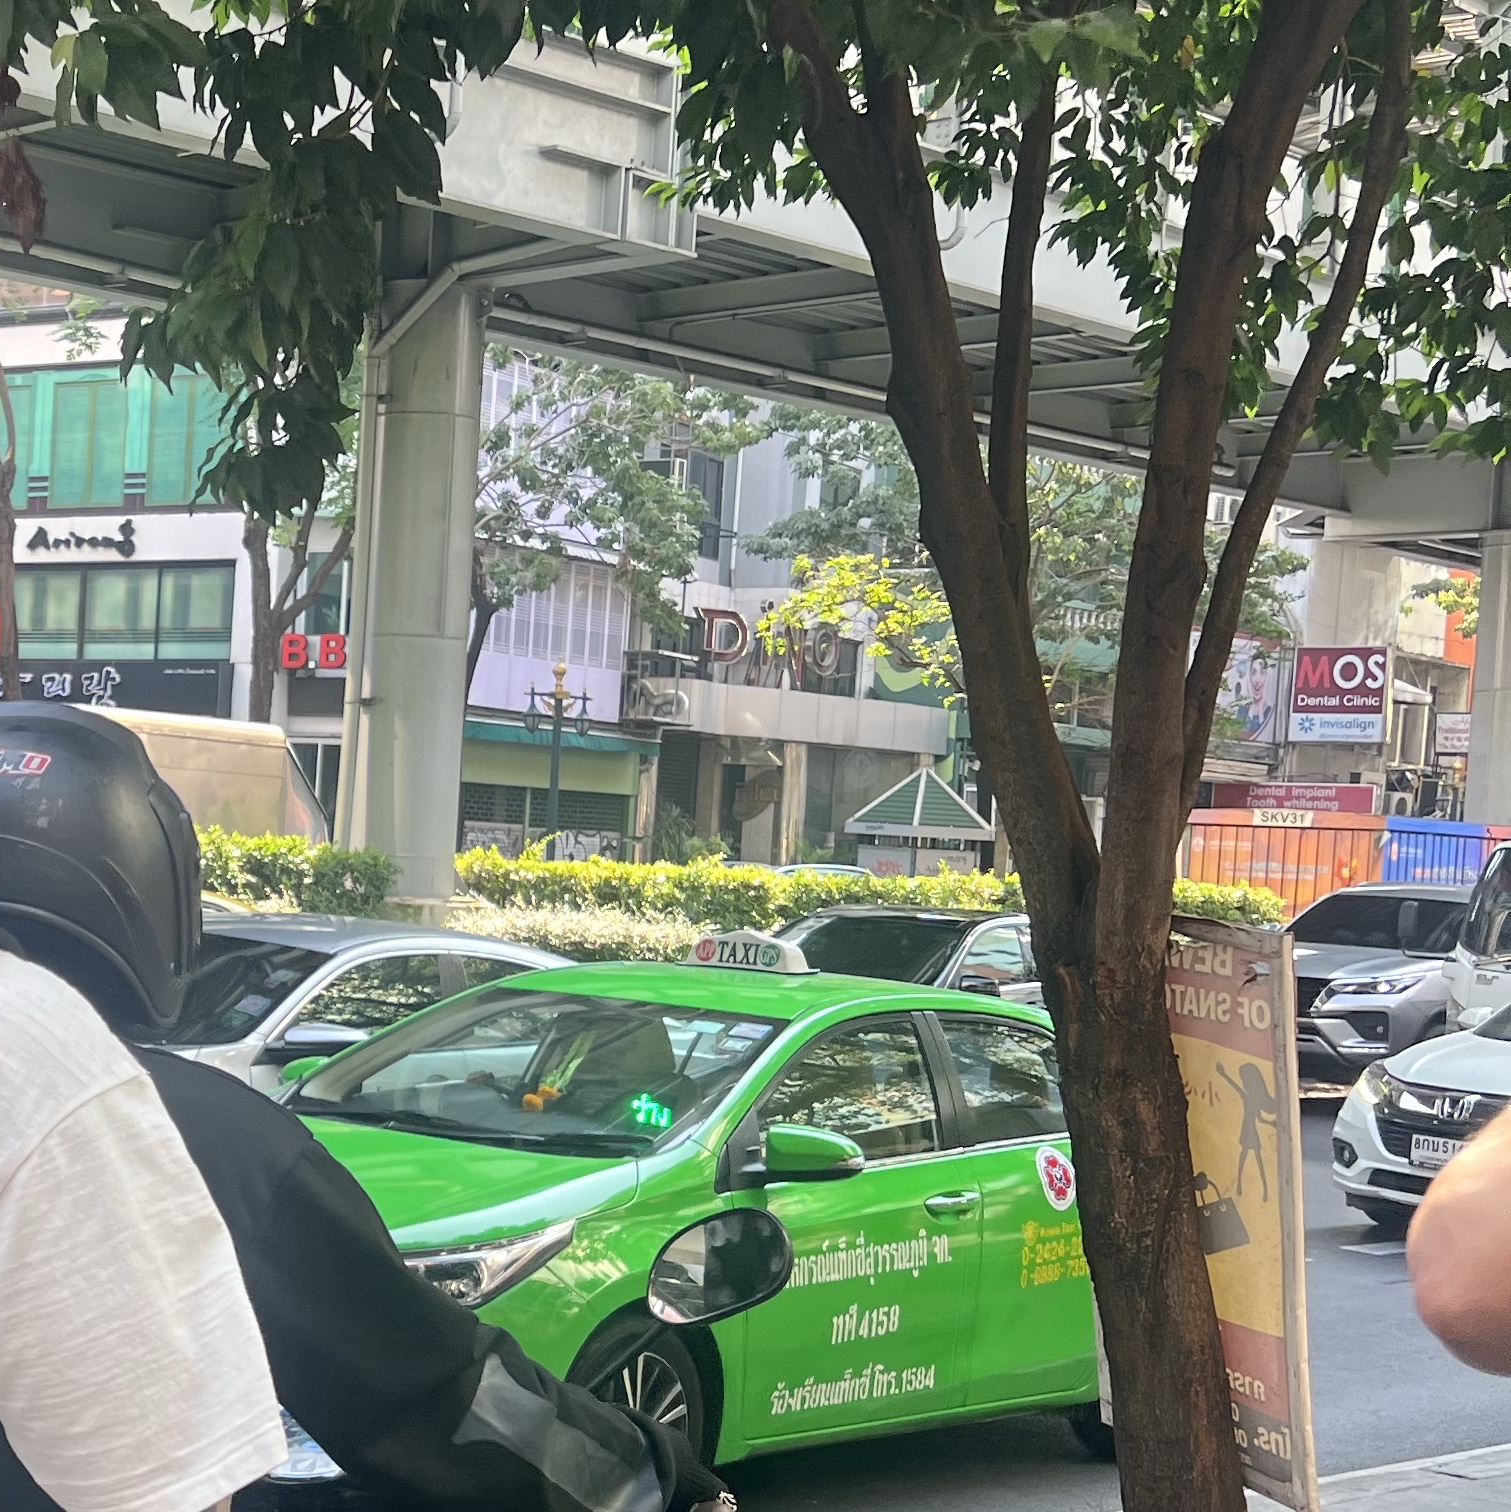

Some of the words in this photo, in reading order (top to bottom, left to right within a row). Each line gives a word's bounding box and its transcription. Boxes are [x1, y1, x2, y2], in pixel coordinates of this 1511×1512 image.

[1296, 653, 1386, 690] MOS
[1297, 694, 1340, 707] Dental
[1343, 694, 1381, 707] Clinic
[1319, 718, 1375, 733] invisalign
[1248, 786, 1286, 797] Dental
[1292, 786, 1337, 799] Implant
[1246, 797, 1277, 808] Tooth
[1283, 798, 1339, 811] whitening
[1260, 811, 1306, 825] SKV31
[717, 941, 761, 966] TAXI
[785, 1228, 928, 1289] หกรณ์แท็กซี่สุวรรณภูมิ
[859, 1304, 900, 1339] 4158
